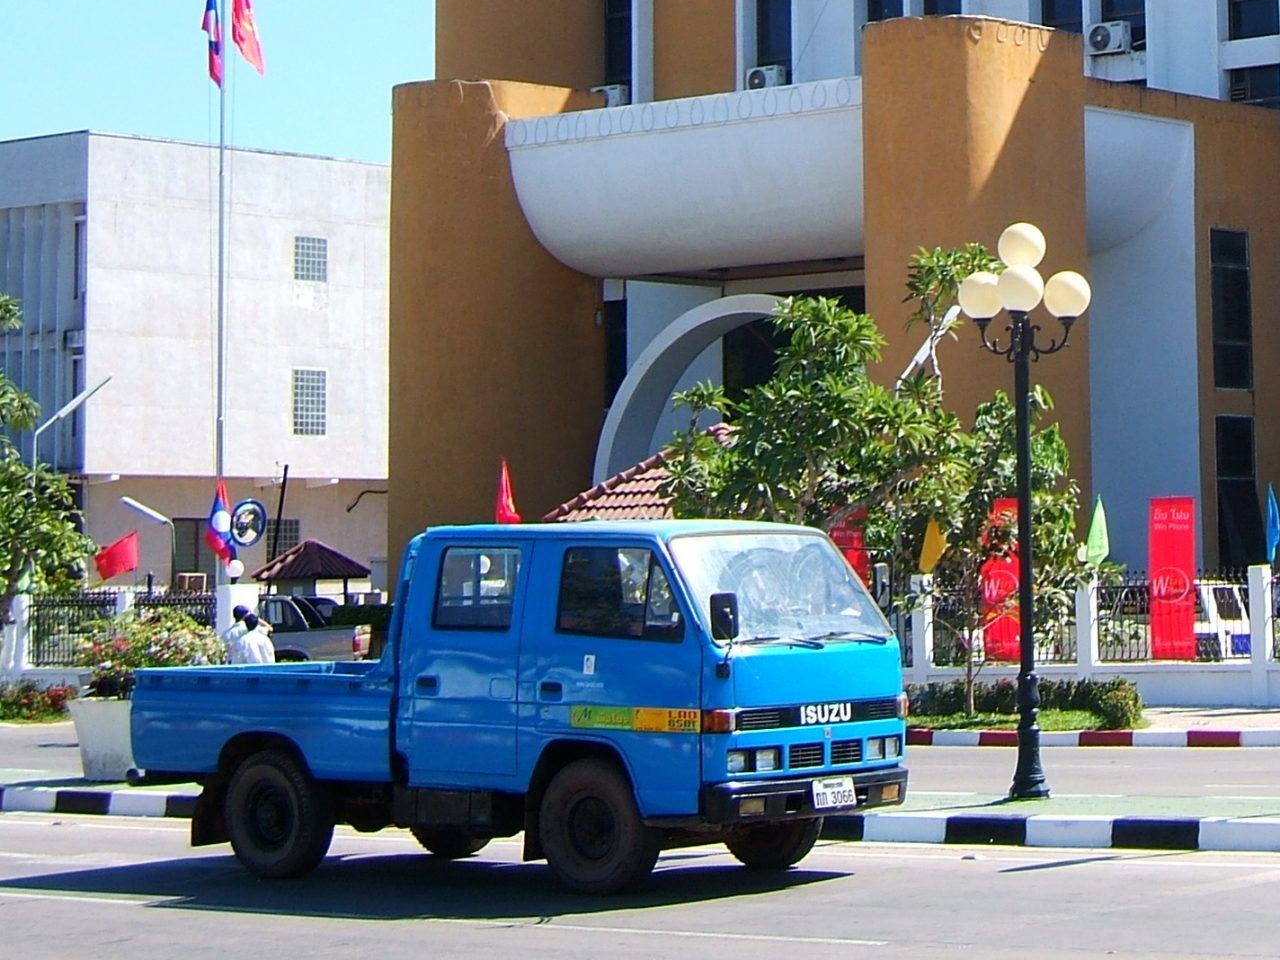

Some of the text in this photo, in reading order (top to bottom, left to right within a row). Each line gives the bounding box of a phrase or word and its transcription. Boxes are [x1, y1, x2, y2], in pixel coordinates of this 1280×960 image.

[668, 710, 698, 720] LAO
[800, 702, 852, 725] ISUZU
[831, 789, 854, 805] 3066
